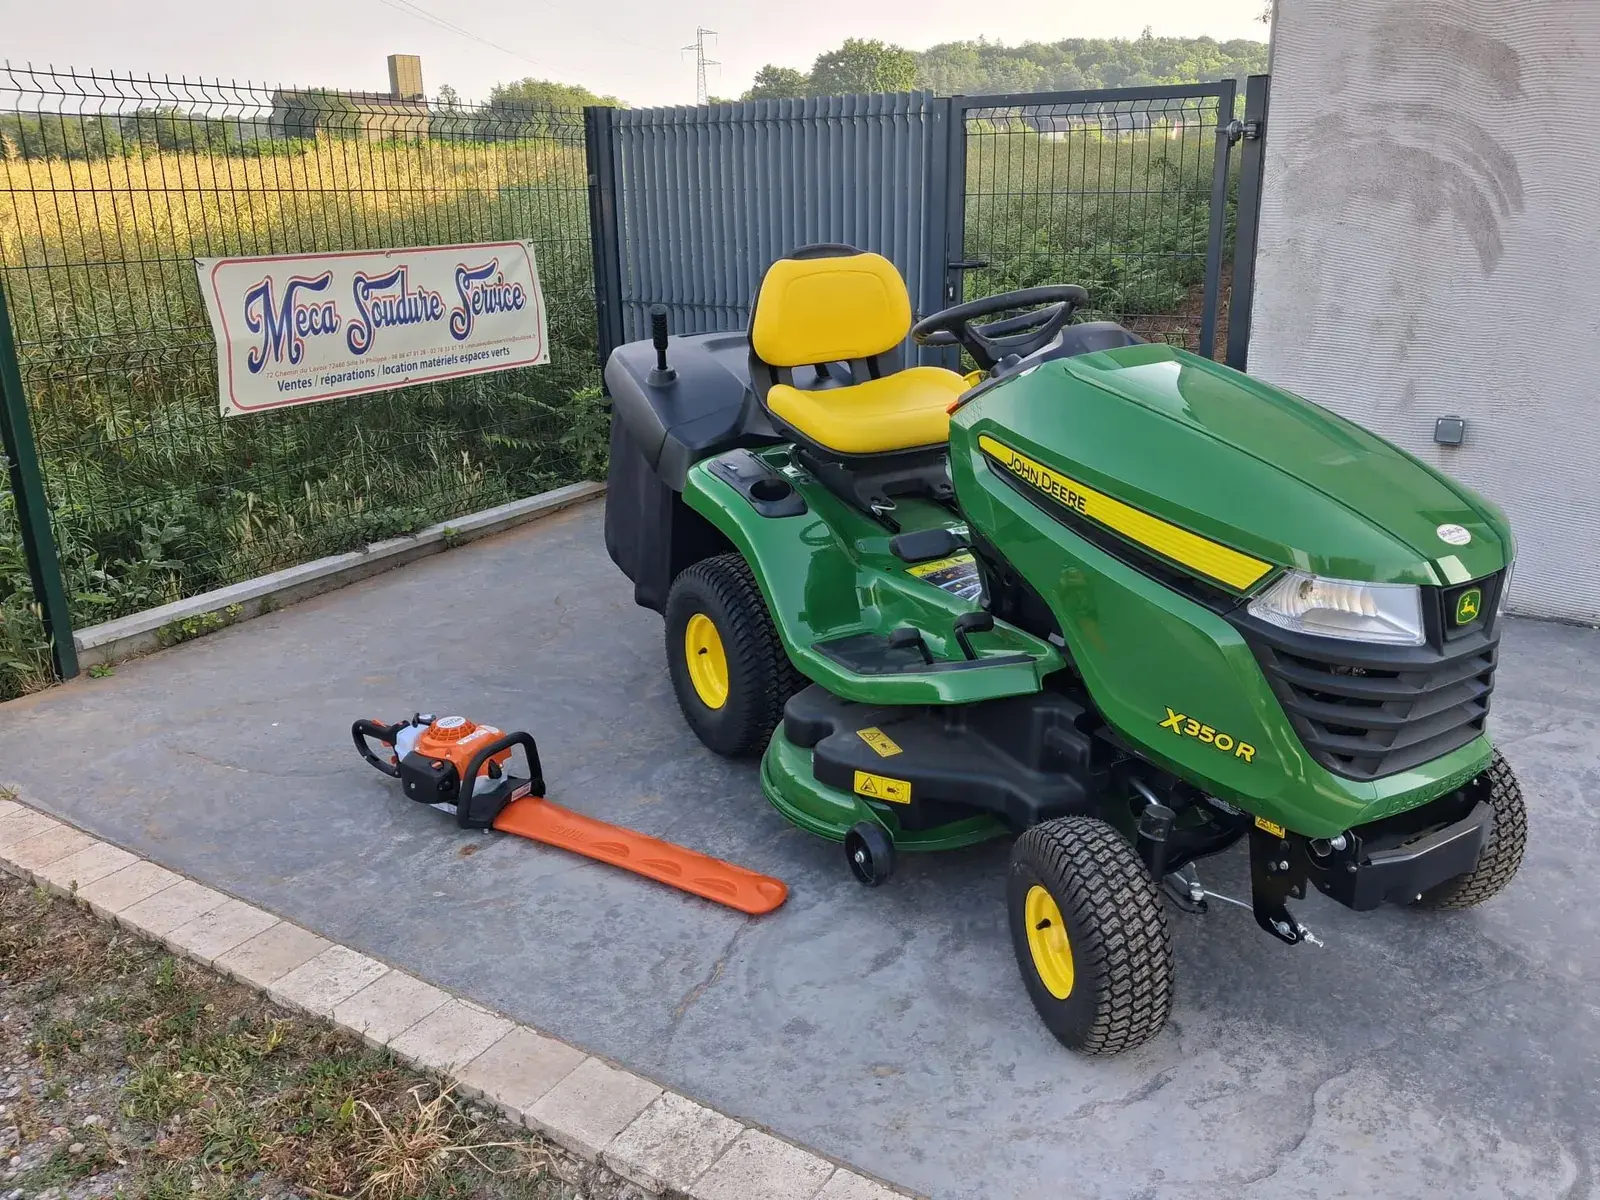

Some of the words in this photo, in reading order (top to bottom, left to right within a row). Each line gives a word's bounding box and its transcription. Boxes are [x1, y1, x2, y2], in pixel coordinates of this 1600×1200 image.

[244, 270, 342, 375] Meca
[346, 265, 446, 357] Soudure
[449, 257, 526, 342] Service
[274, 369, 298, 377] Chemin
[309, 365, 327, 373] Lavoir
[277, 378, 312, 392] Ventes
[320, 368, 375, 387] réparations
[382, 360, 418, 376] location
[420, 353, 458, 369] matériels
[459, 350, 490, 364] espaces
[491, 346, 510, 358] verts
[1006, 452, 1039, 485] JOHN
[1041, 471, 1087, 512] DEERE
